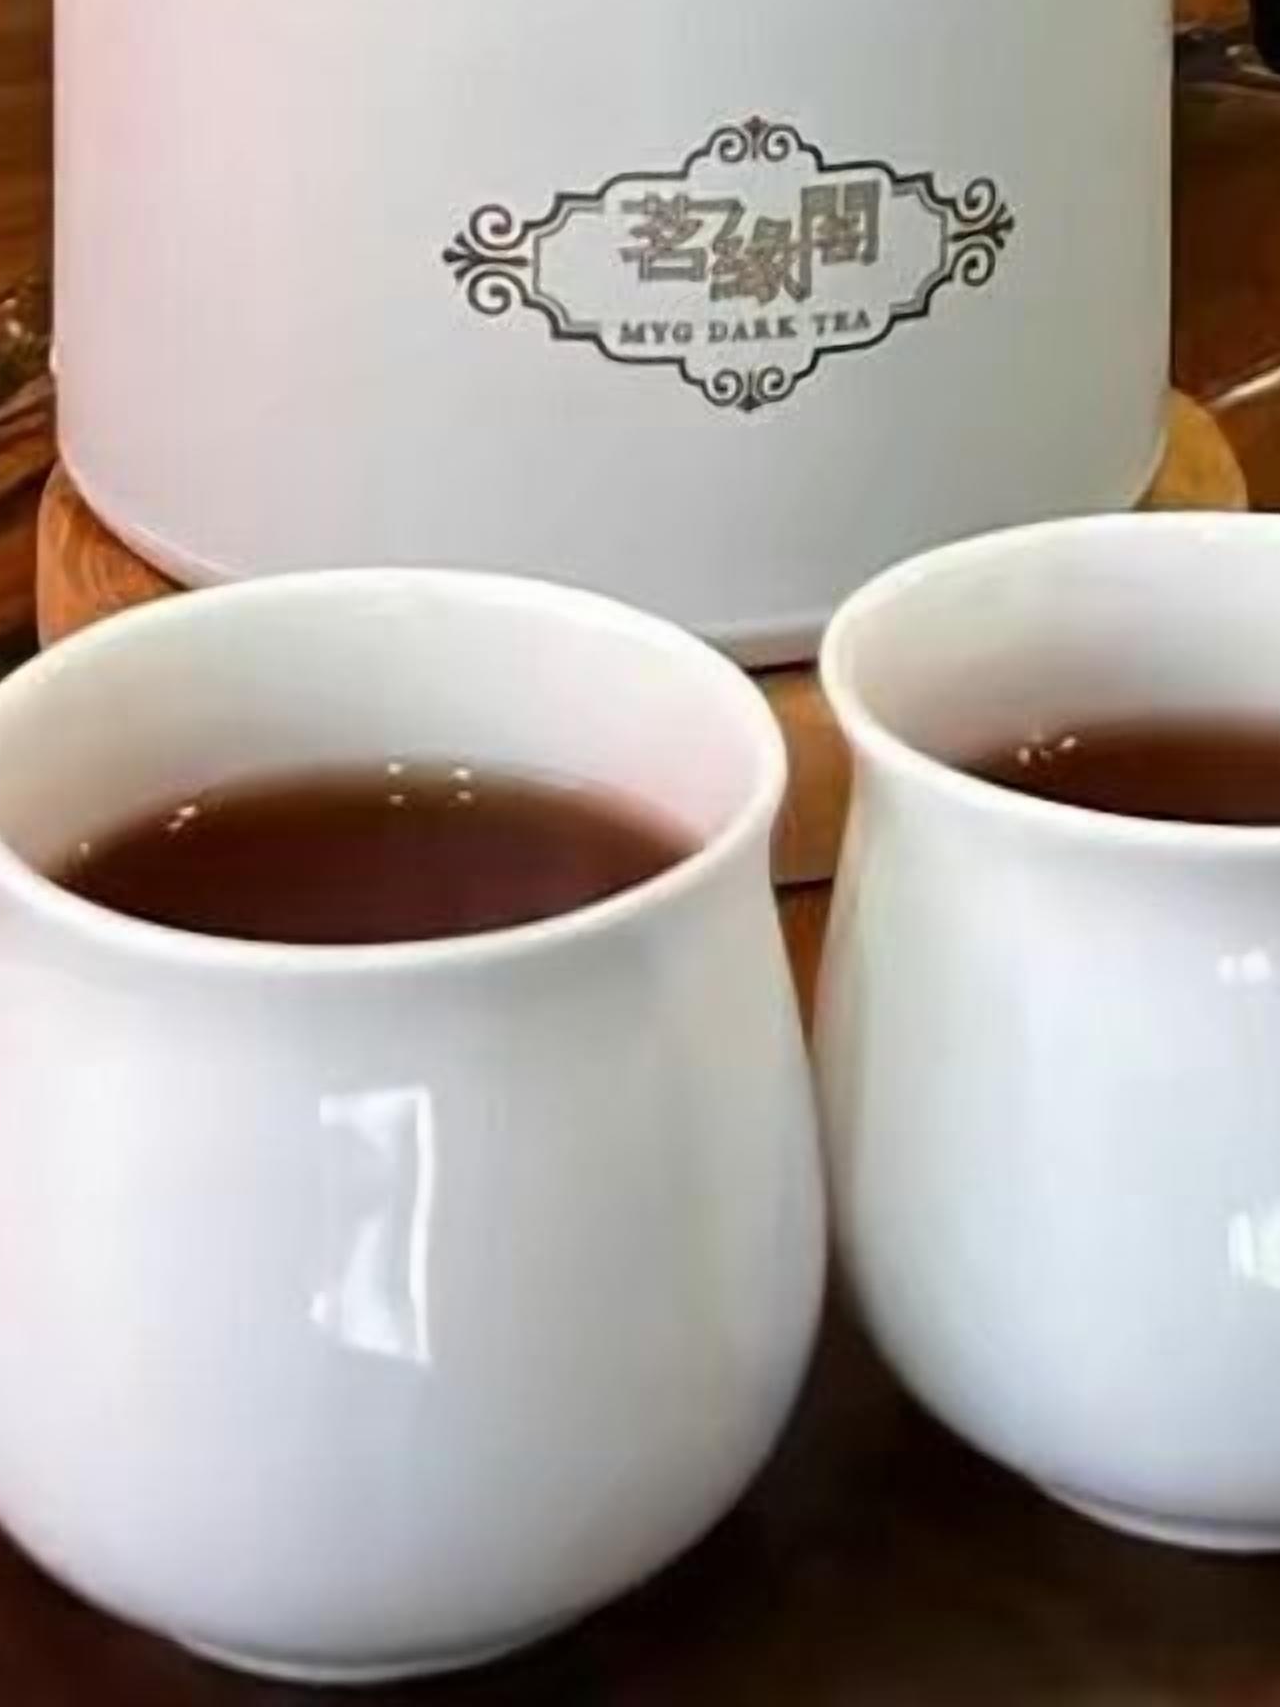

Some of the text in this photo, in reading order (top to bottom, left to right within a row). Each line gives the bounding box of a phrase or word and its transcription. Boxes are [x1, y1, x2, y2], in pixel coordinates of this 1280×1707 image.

[620, 310, 870, 345] MYG DARK TEA
